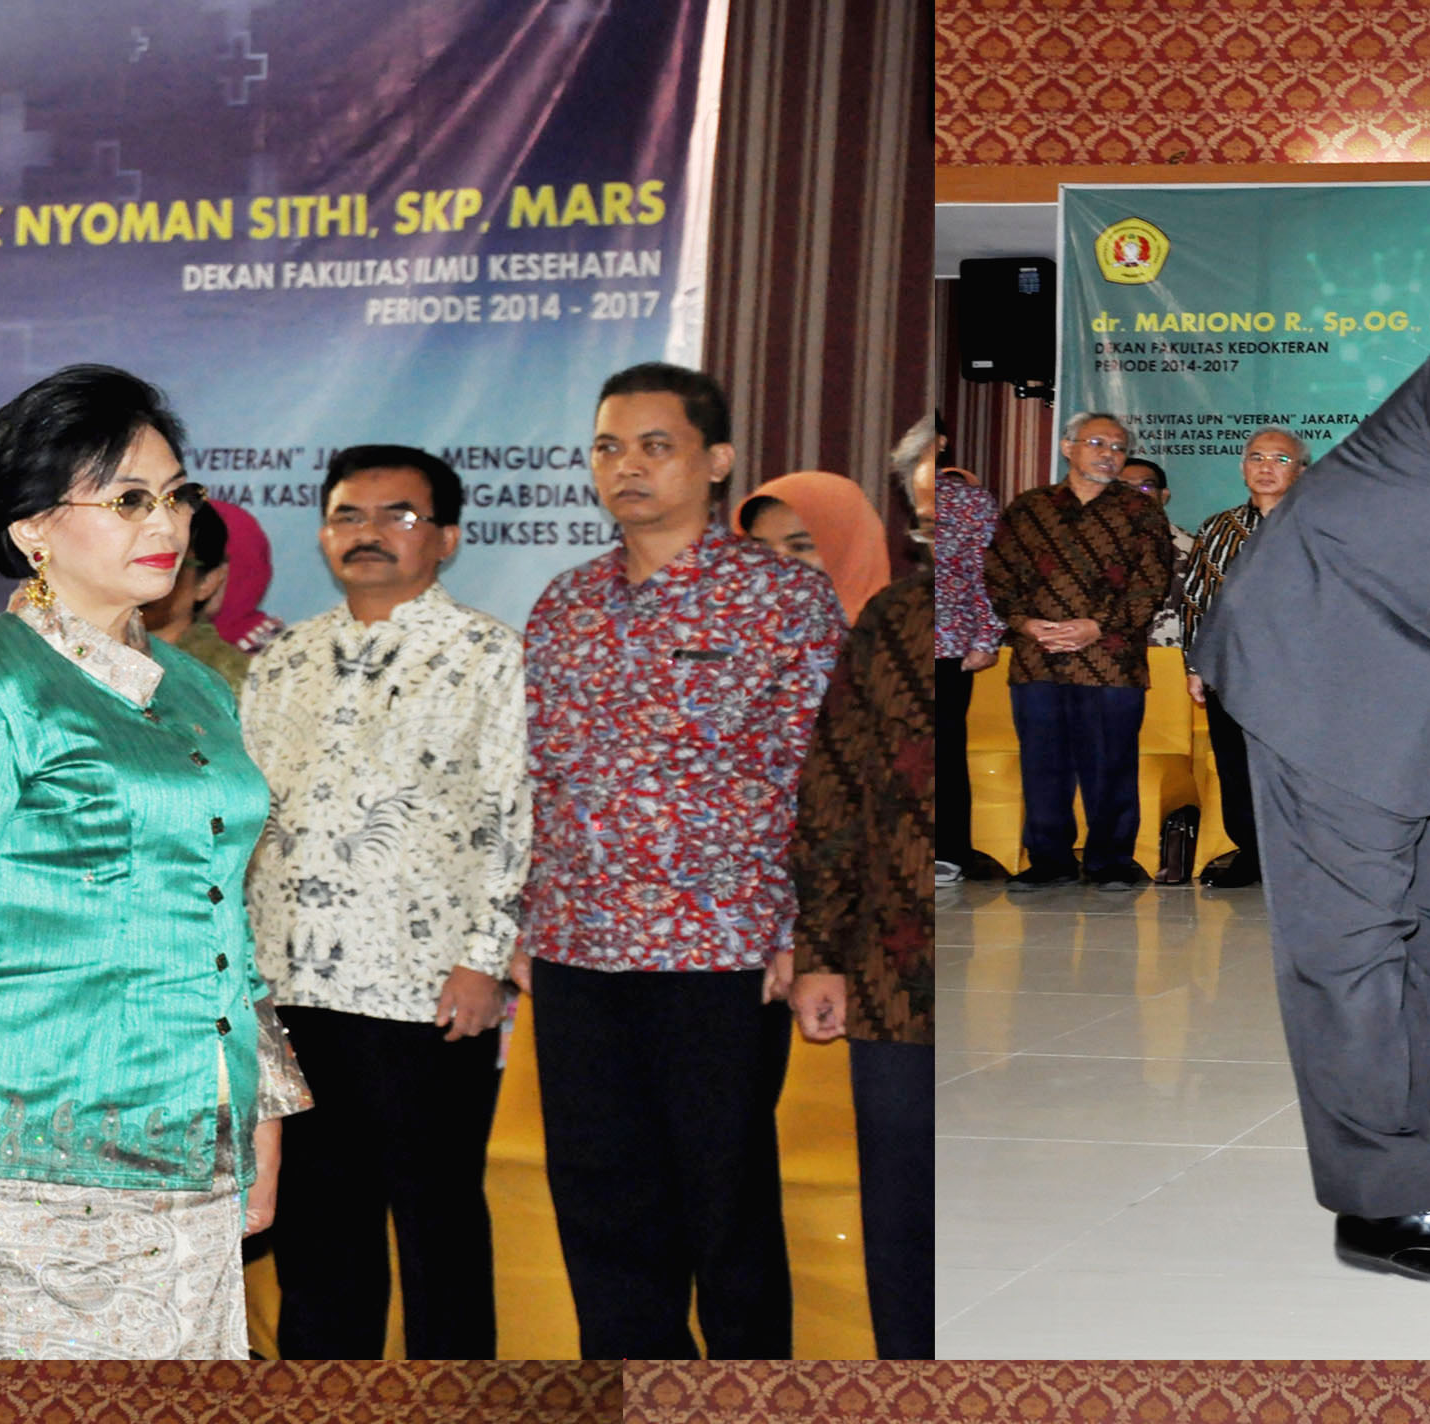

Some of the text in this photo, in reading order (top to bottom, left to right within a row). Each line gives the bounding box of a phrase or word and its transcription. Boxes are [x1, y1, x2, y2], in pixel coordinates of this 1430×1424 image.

[15, 198, 233, 247] NYOMAN
[248, 194, 378, 240] SITHI,
[509, 180, 667, 229] MARS
[183, 249, 662, 291] DEKAN FAKULTAS ILMU KESEHATAN
[366, 296, 482, 325] PERIODE
[490, 294, 561, 323] 2014
[590, 291, 662, 320] 2017
[1091, 311, 1127, 332] dr.
[1134, 312, 1276, 332] MARIONO
[1151, 341, 1223, 354] FAKULTAS
[1228, 341, 1328, 354] KEDOKTERAN
[1095, 359, 1239, 373] PERIODE 2014-2017
[1146, 414, 1193, 425] SIVITAS
[1197, 414, 1223, 425] UPN
[1227, 414, 1297, 425] "VETERAN"
[1300, 413, 1360, 425] JAKARTA
[1138, 429, 1176, 440] KASIH
[1180, 429, 1213, 440] ATAS
[183, 446, 305, 471] "VETERAN"
[442, 446, 590, 470] MENGUCA
[1151, 444, 1195, 455] SUKSES
[1199, 444, 1244, 455] SELALU
[263, 483, 322, 507] KASI
[466, 520, 623, 545] SUKSES SELA
